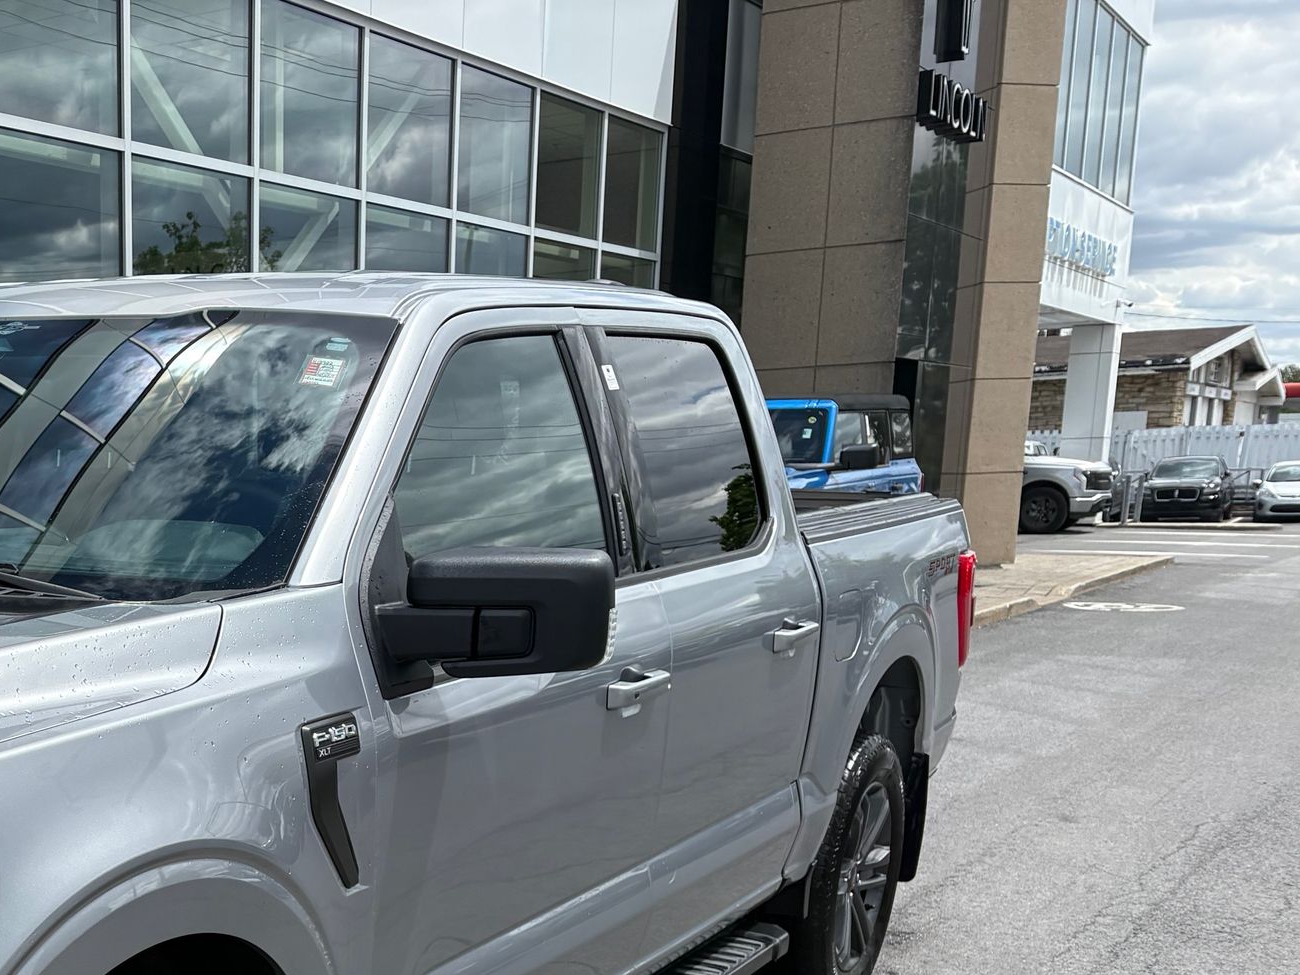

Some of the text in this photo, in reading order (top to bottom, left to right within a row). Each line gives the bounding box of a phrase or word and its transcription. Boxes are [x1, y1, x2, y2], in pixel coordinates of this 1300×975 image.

[926, 69, 987, 142] LINCOLN
[313, 723, 356, 747] F-150
[319, 747, 332, 757] XLT
